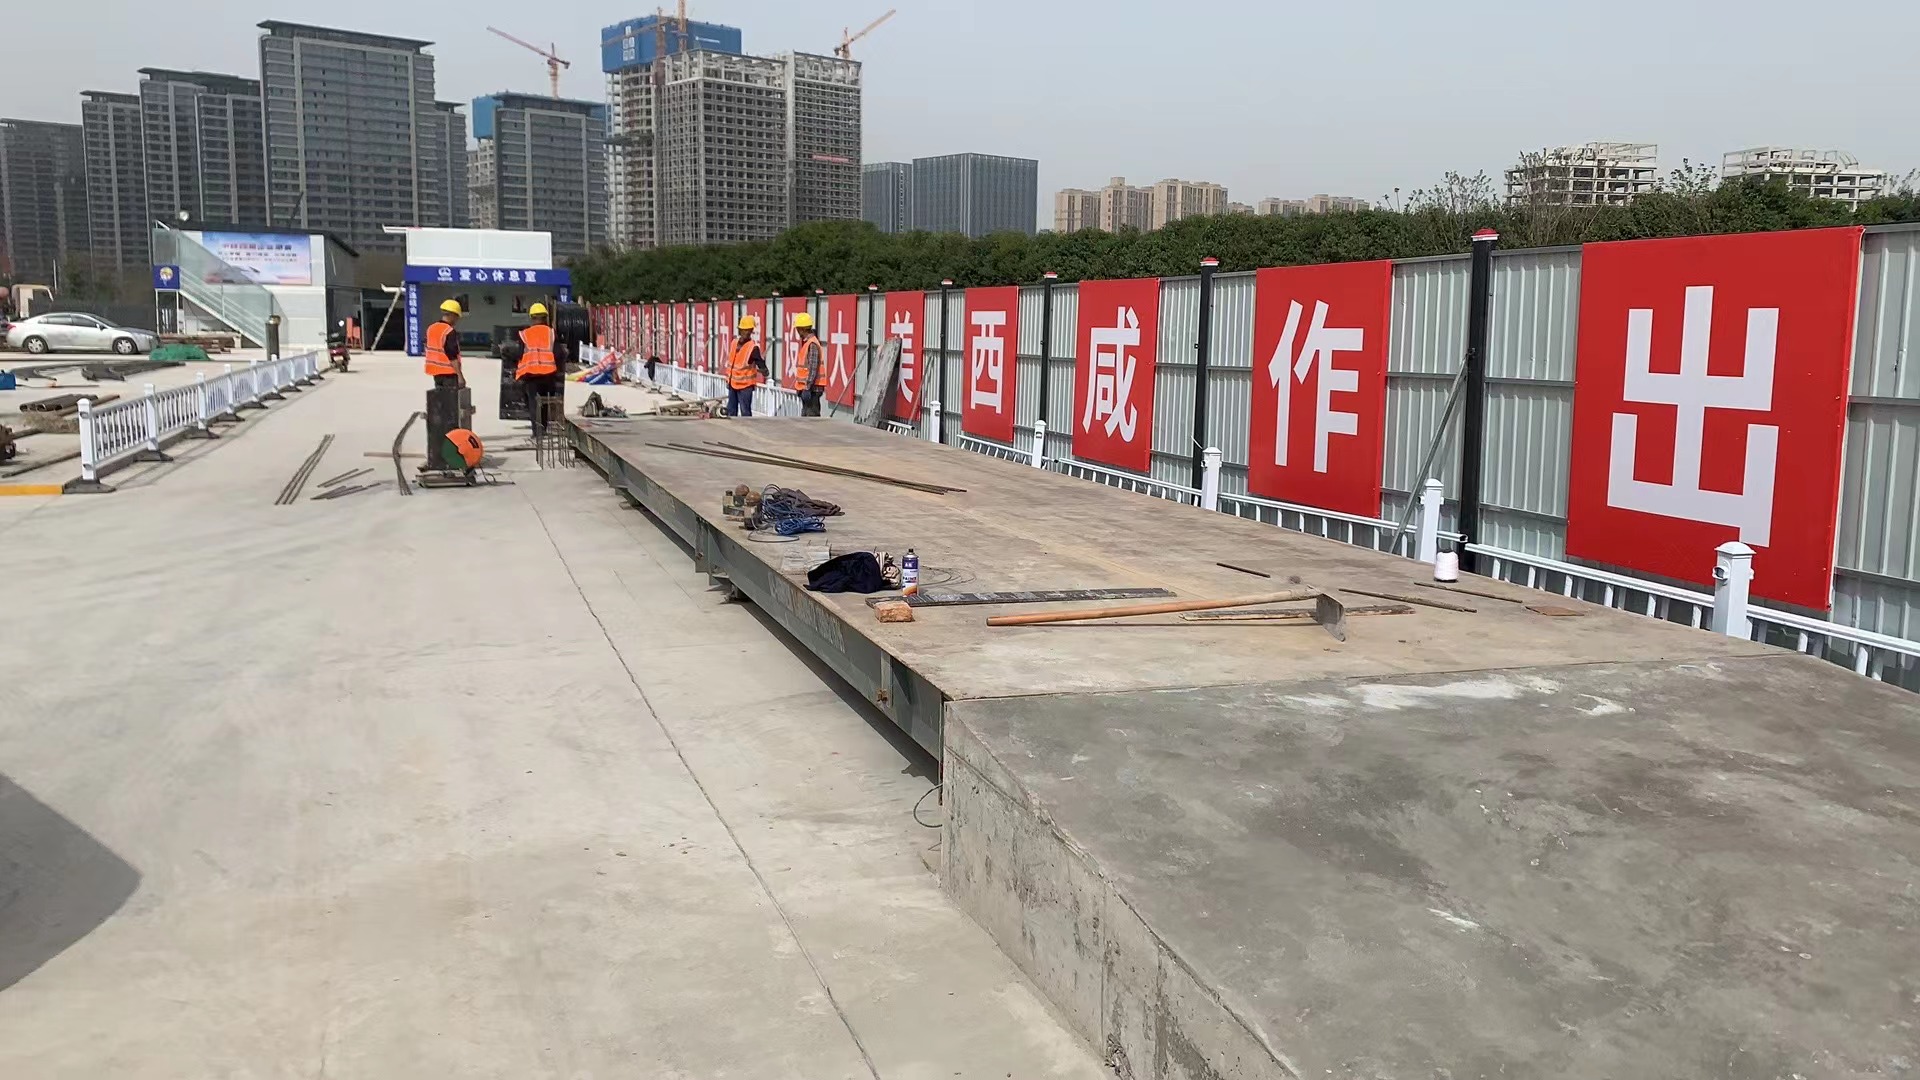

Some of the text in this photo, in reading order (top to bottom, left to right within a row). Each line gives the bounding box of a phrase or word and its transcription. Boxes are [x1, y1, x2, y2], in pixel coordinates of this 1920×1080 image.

[459, 268, 537, 283] 爱心休息室
[829, 310, 850, 389] 大
[890, 309, 914, 404] 美
[970, 310, 1007, 414] 西
[1082, 305, 1141, 443] 咸
[1268, 298, 1365, 475] 作
[1607, 284, 1781, 549] 出
